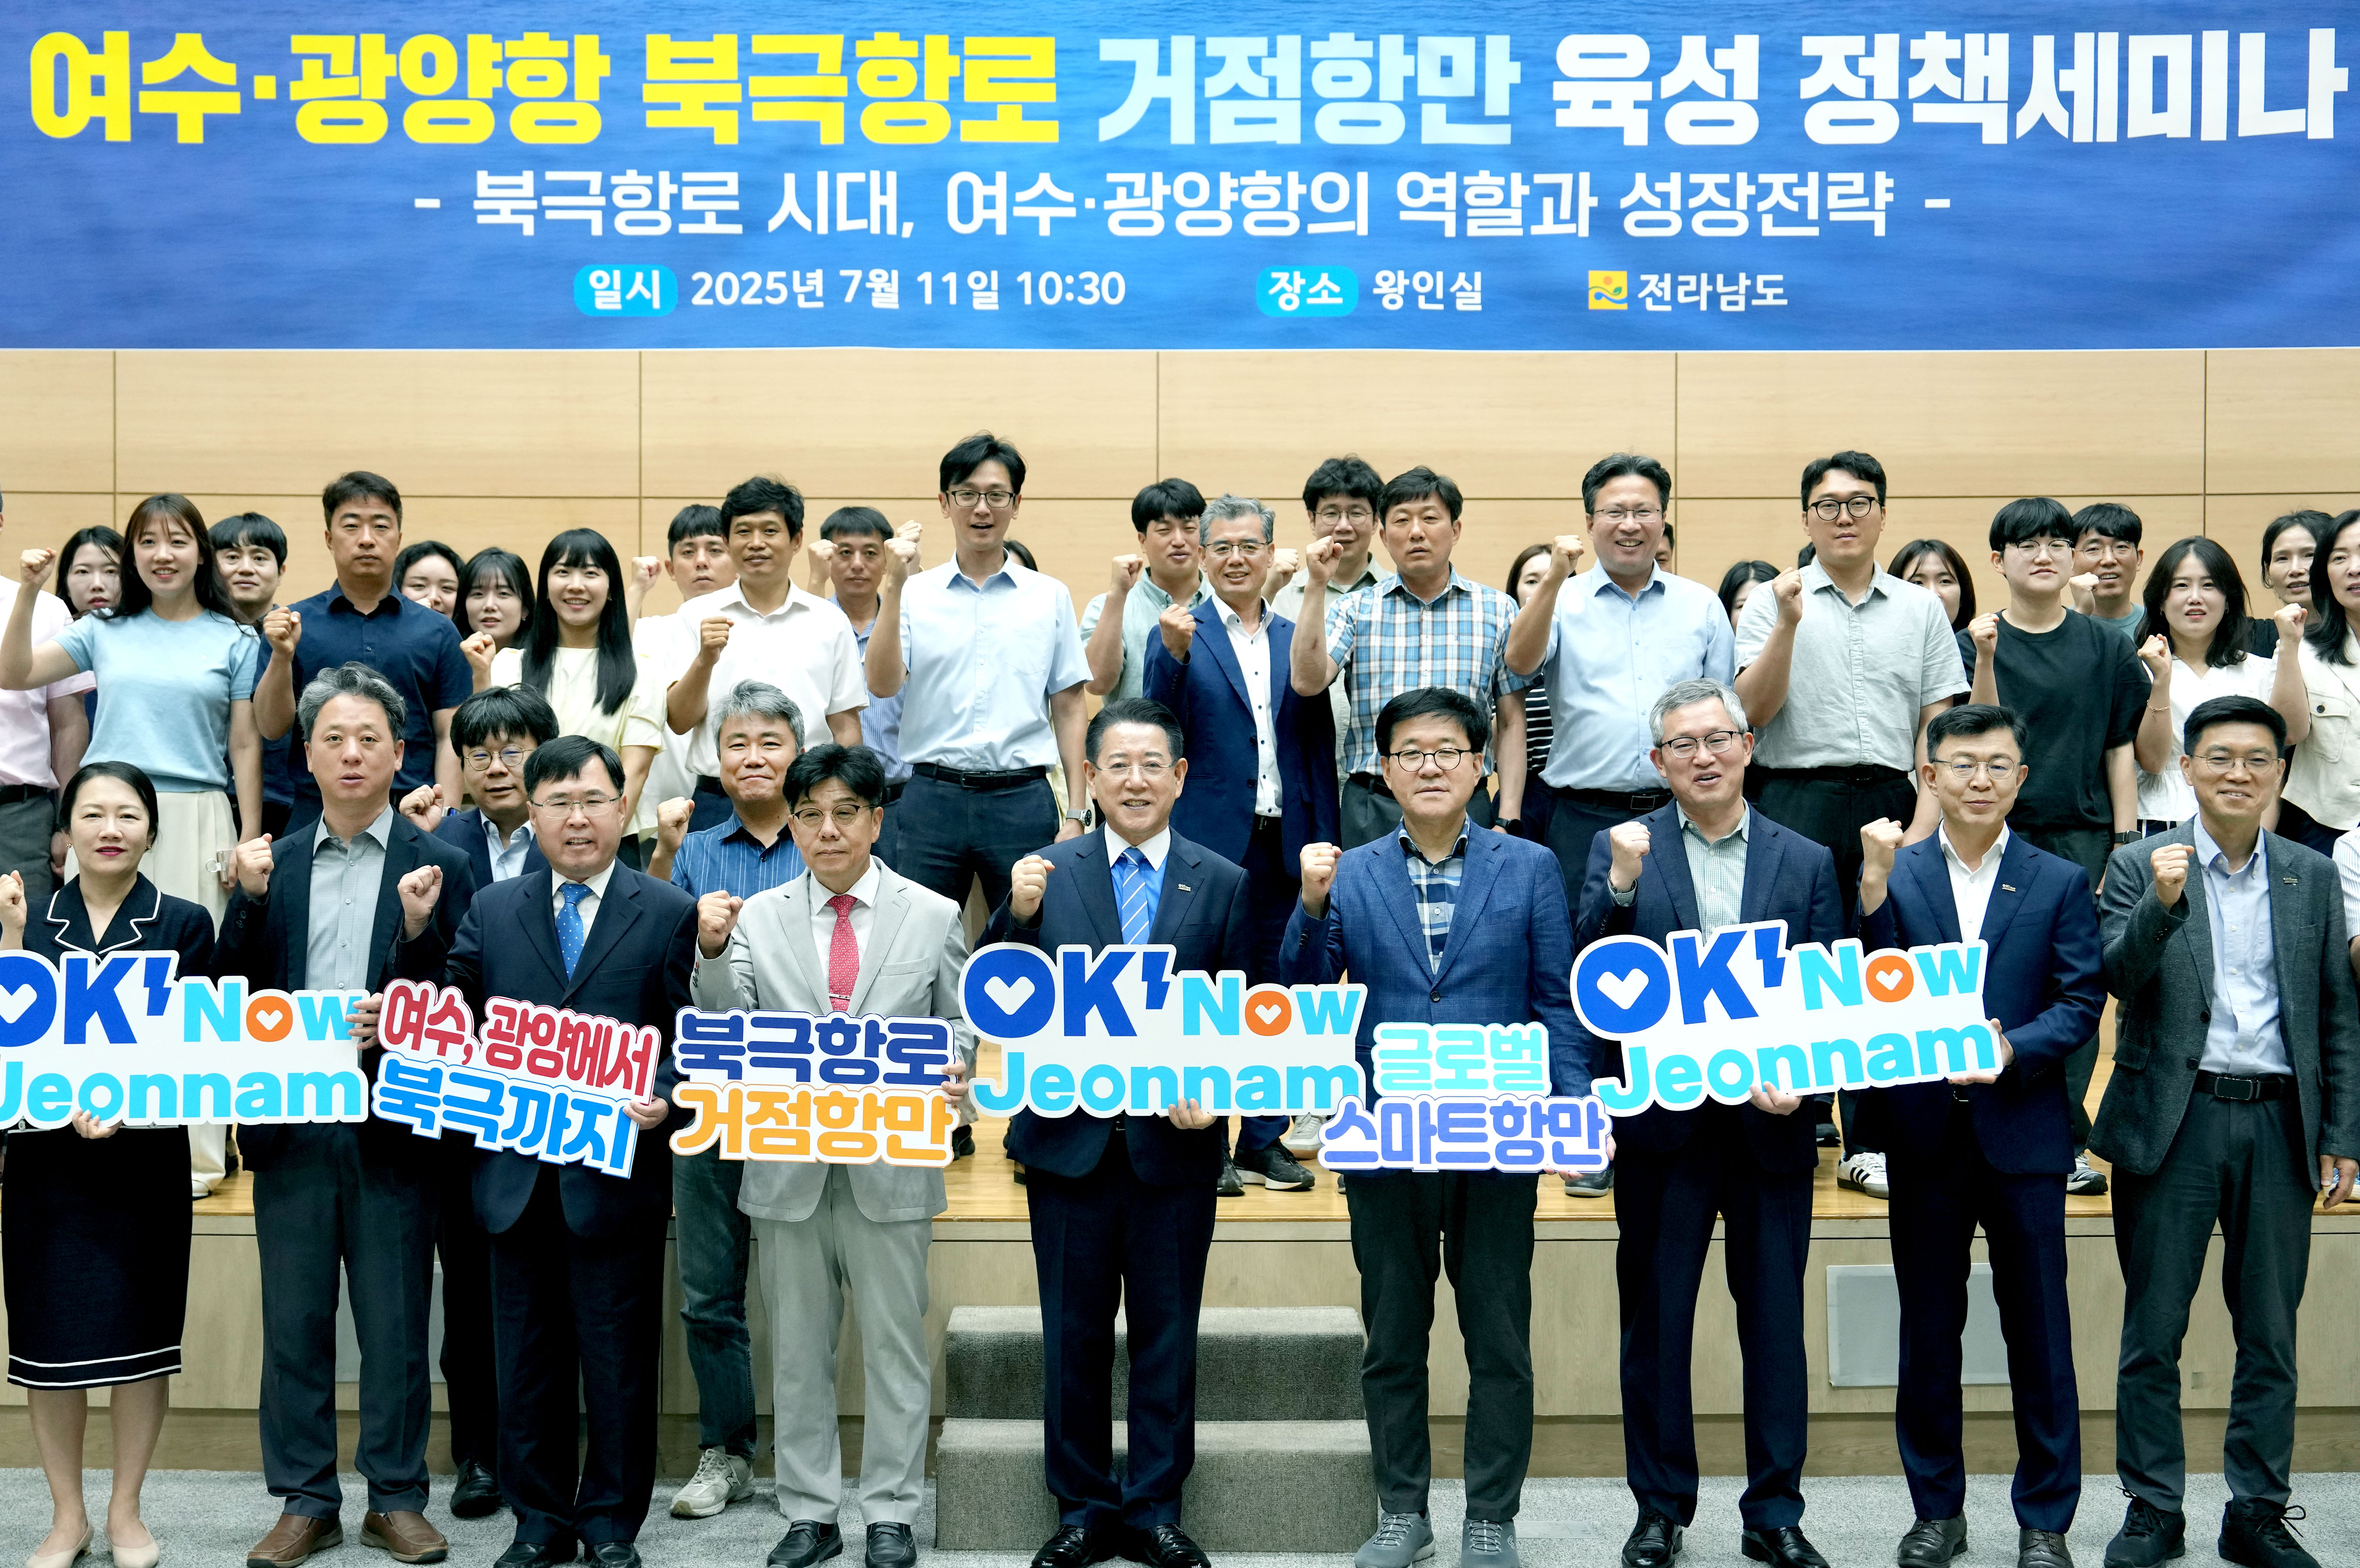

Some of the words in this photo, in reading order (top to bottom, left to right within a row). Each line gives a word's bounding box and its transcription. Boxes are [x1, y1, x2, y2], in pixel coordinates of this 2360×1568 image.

[31, 31, 610, 143] 여수·광양항
[643, 32, 1058, 144] 북극항로
[1098, 33, 1520, 145] 거점항만
[1553, 34, 1759, 146] 육성
[1800, 28, 2349, 145] 정책세미나
[473, 170, 743, 236] 북극항로
[768, 170, 914, 238] 시대,
[947, 170, 1368, 236] 여수·광양항의
[1397, 170, 1598, 237] 역할과
[1620, 171, 1894, 237] 성장전략
[590, 270, 660, 309] 일시
[692, 269, 824, 308] 2025년
[840, 269, 899, 309] 7월
[917, 270, 999, 310] 11일
[1017, 271, 1126, 305] 10:30
[1269, 271, 1343, 311] 장소
[1373, 270, 1482, 311] 왕인실
[1638, 272, 1788, 311] 전라남도
[385, 984, 473, 1065] 여수,
[486, 1004, 653, 1096] 광양에서
[678, 1013, 951, 1085] 북극항로
[1378, 1028, 1545, 1091] 글로벌
[1598, 1024, 1996, 1109] Jeonnam
[379, 1058, 631, 1170] 북극까지
[974, 1052, 1359, 1111] Jeonnam
[677, 1088, 953, 1160] 거점항만
[1324, 1100, 1605, 1165] 스마트항만
